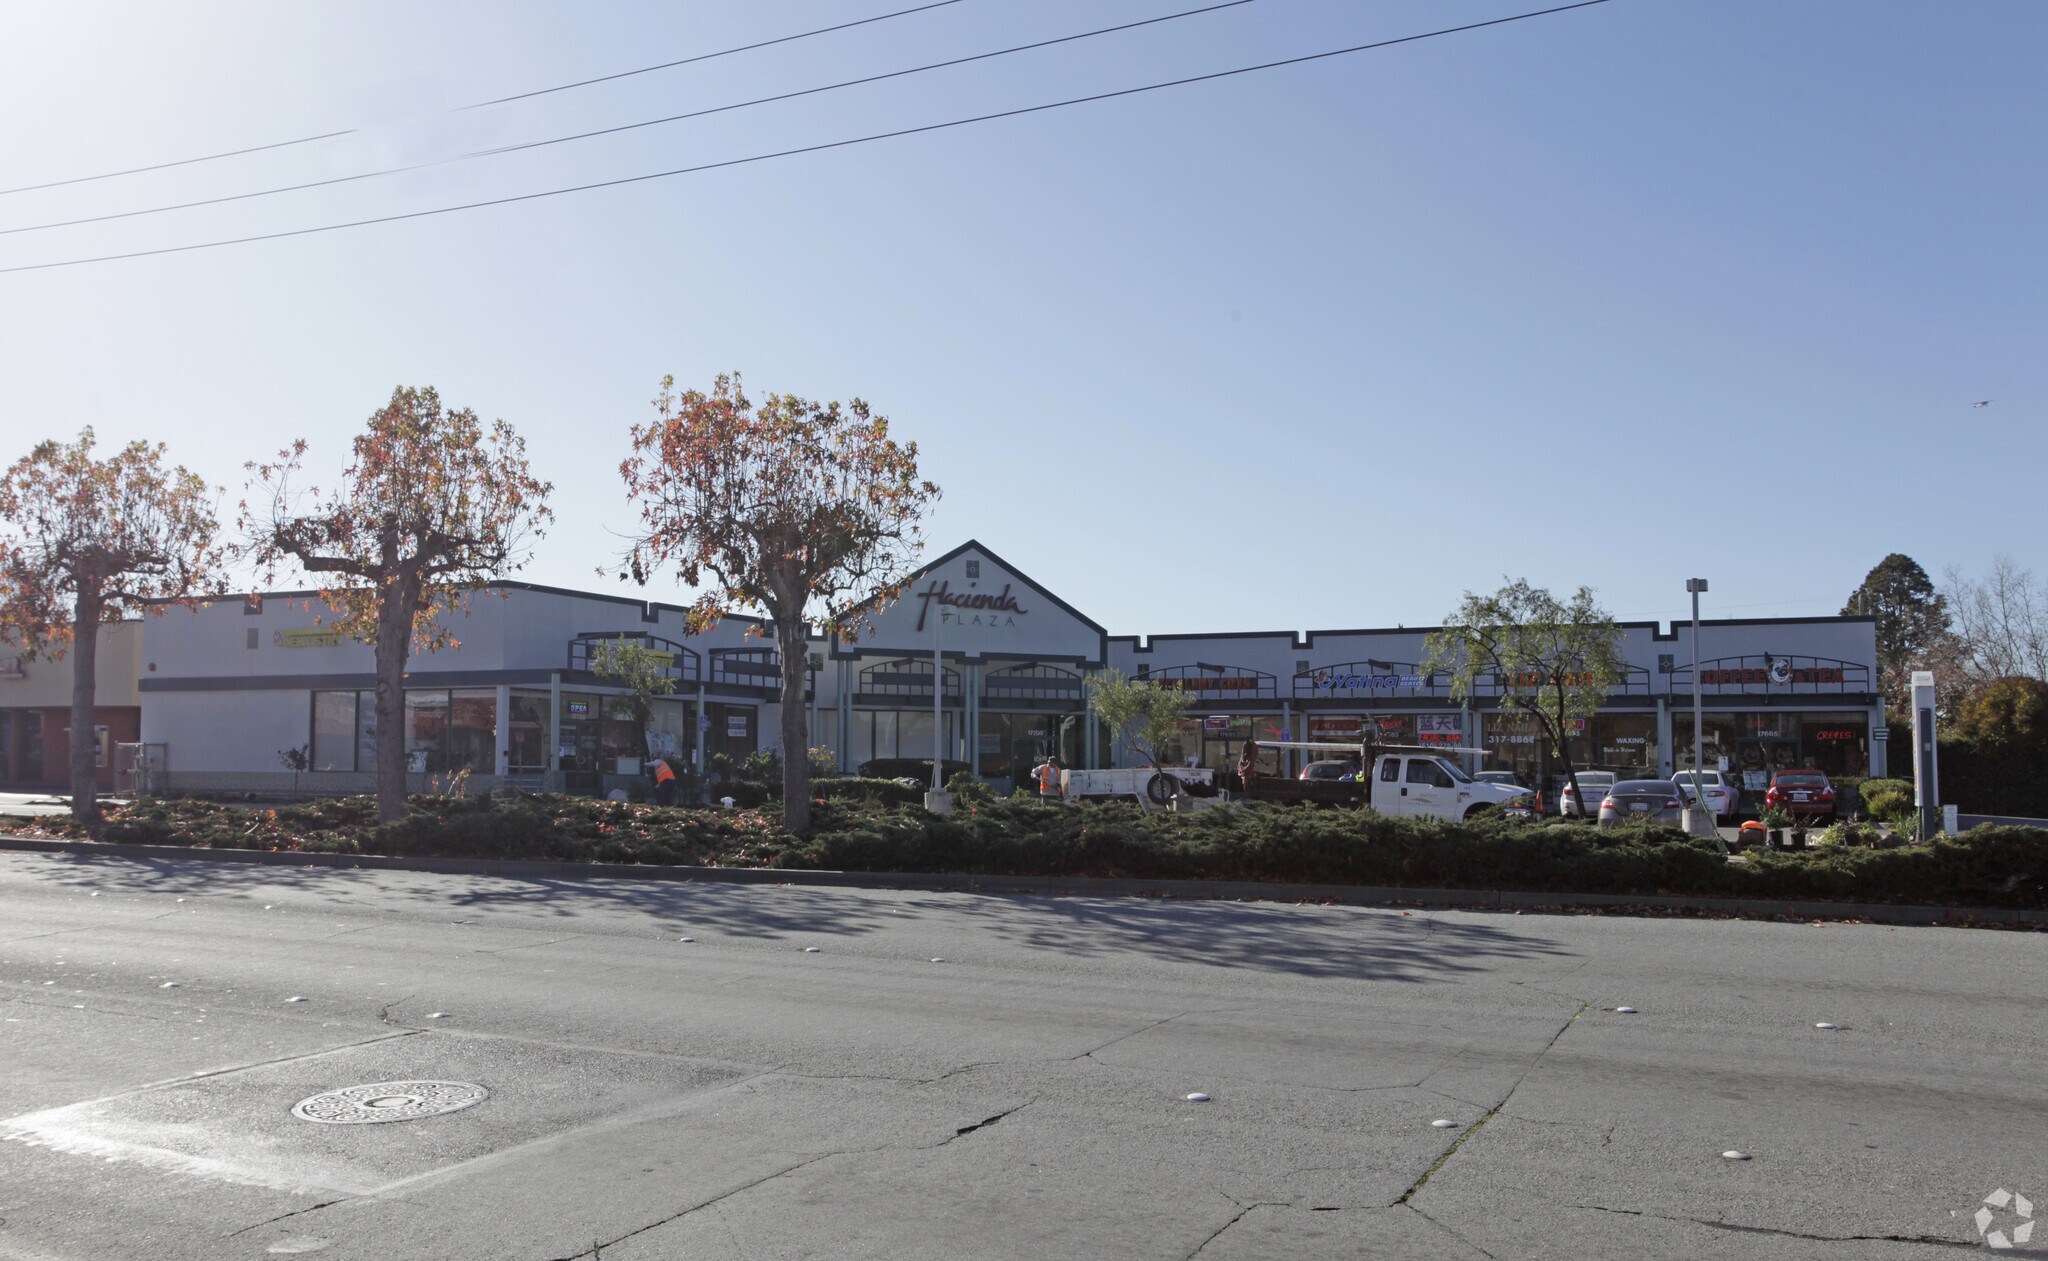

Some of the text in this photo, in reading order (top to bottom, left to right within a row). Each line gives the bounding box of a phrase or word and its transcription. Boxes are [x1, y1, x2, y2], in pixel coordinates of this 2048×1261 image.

[917, 580, 1028, 632] Hacienda
[941, 613, 1015, 627] PLAZA
[1319, 673, 1398, 688] Natina
[1806, 668, 1843, 683] TEA
[570, 704, 586, 713] OPEN
[1488, 723, 1504, 731] LIZ
[1816, 731, 1852, 740] CREPES
